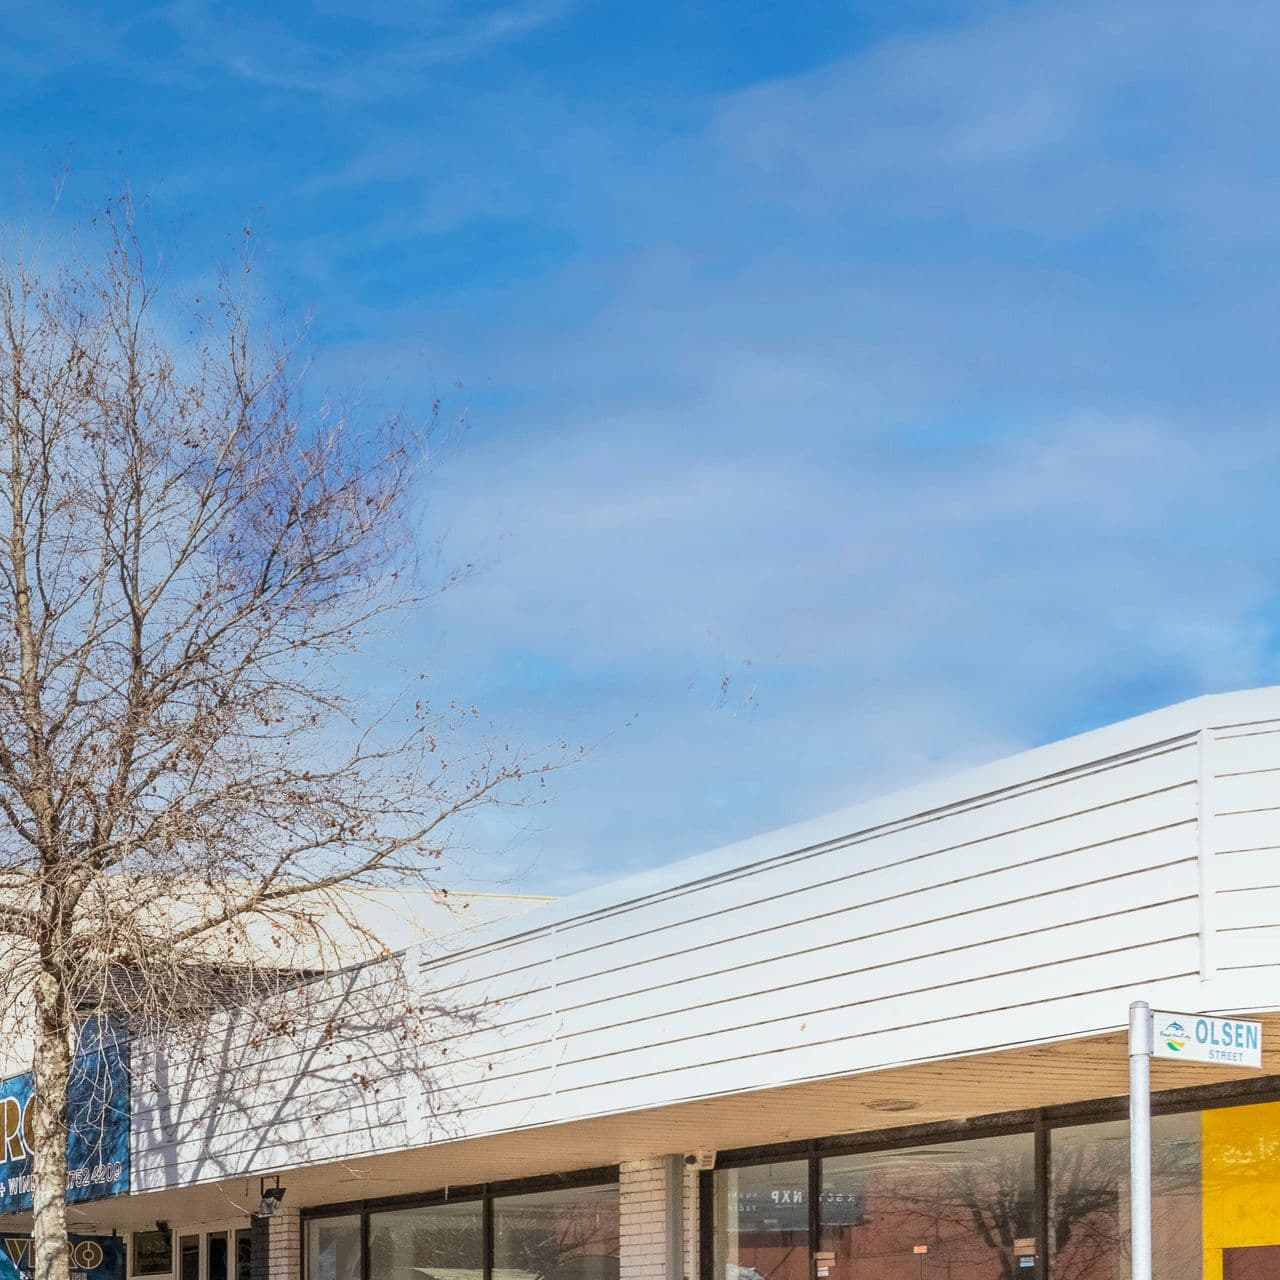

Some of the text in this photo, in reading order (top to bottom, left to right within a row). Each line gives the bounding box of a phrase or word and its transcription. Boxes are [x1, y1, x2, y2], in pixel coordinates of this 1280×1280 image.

[1196, 1019, 1258, 1049] OLSEN
[1208, 1049, 1243, 1061] STREET
[66, 1167, 90, 1190] 752
